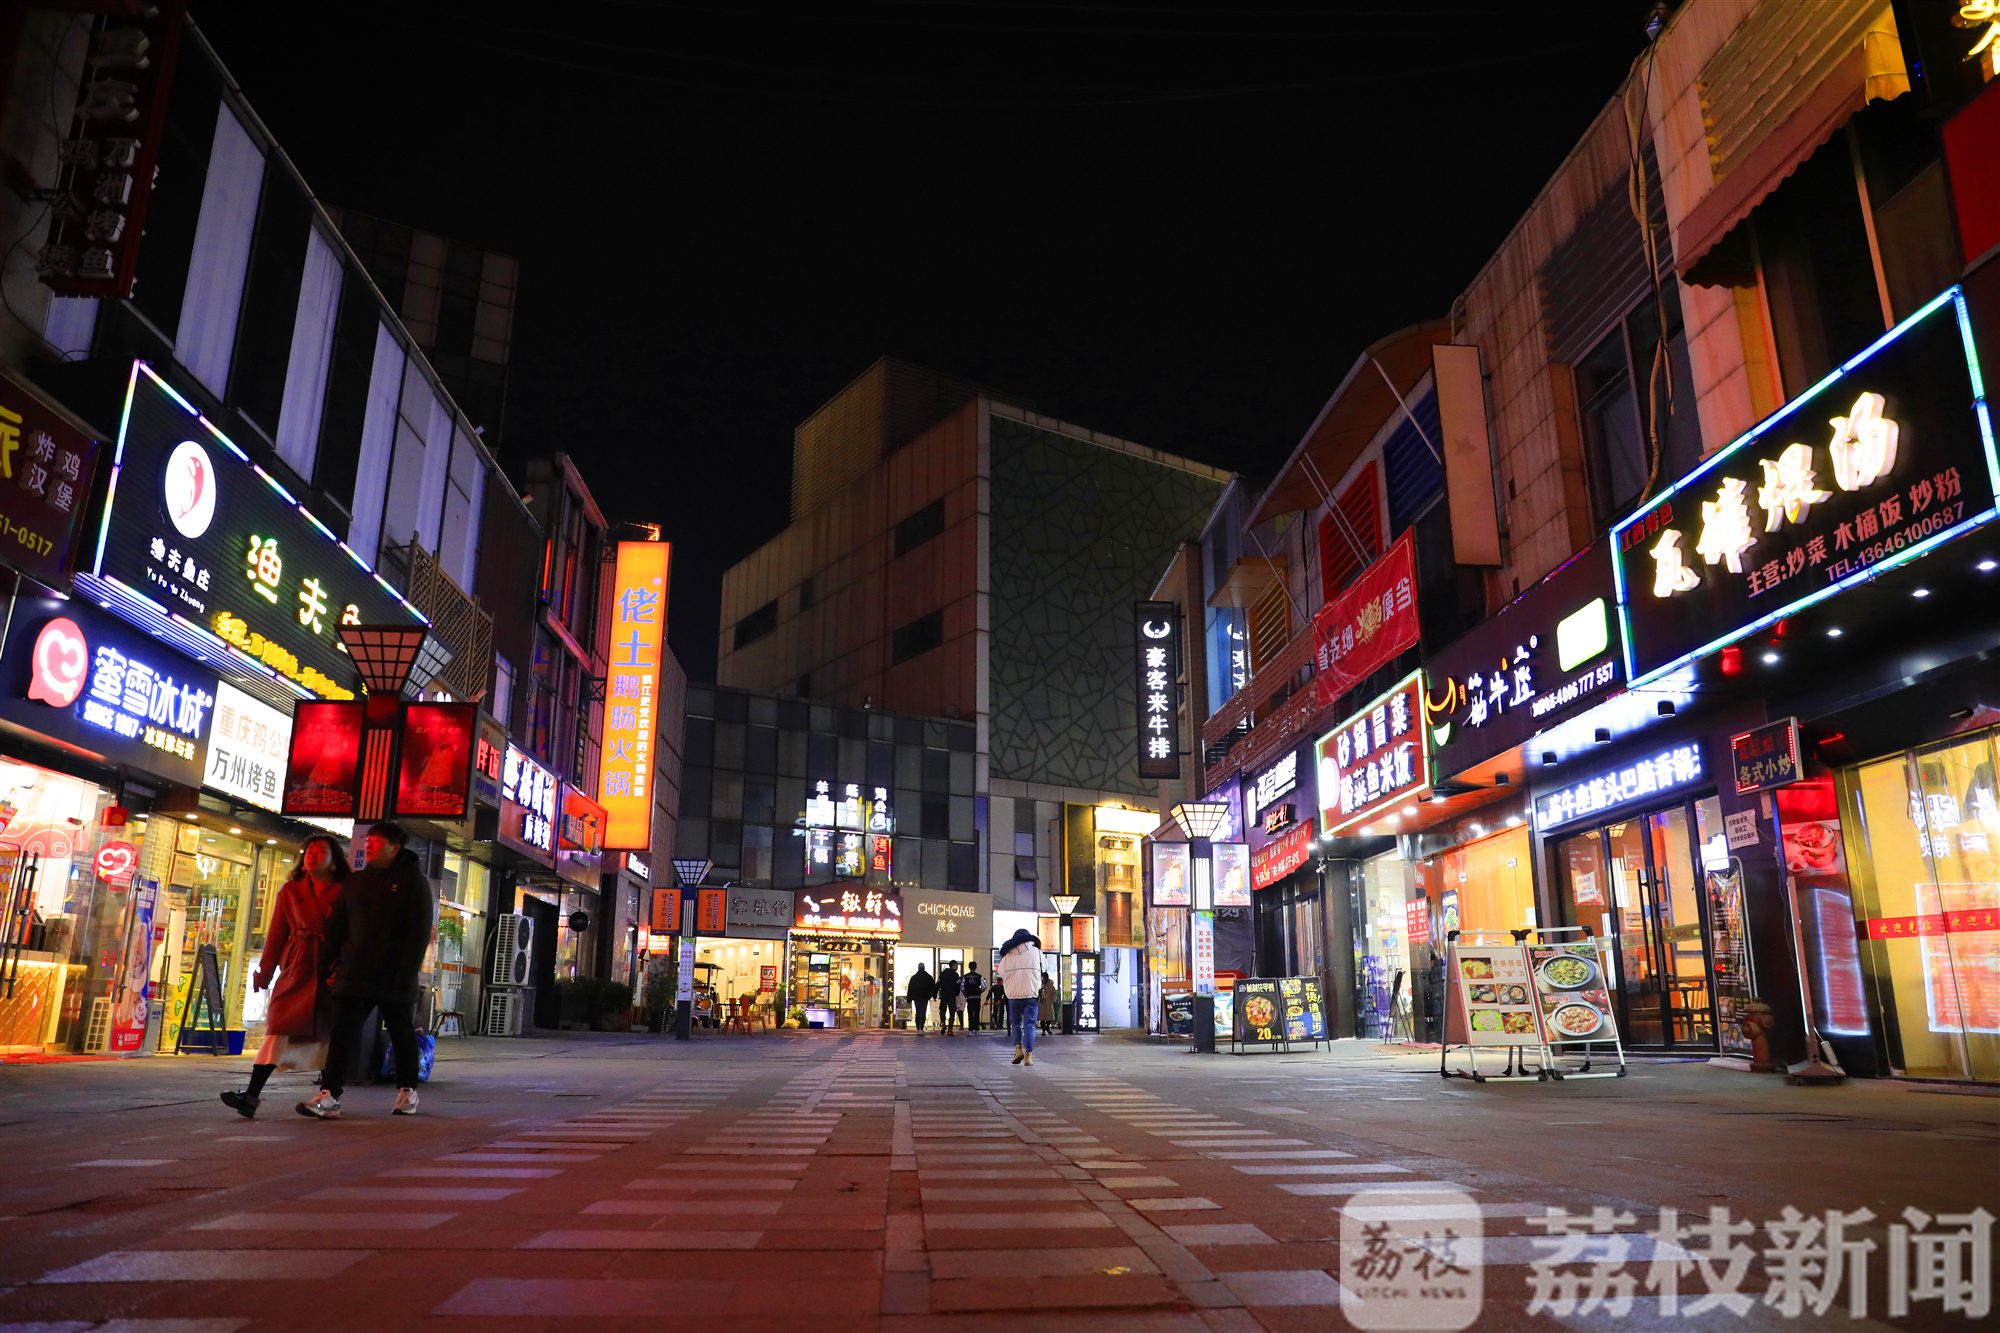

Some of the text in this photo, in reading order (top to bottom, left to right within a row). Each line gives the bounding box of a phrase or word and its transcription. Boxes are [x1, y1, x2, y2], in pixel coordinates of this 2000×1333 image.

[35, 431, 81, 482] 炸鸡
[28, 463, 74, 513] 汉堡
[1909, 466, 1961, 514] 炒粉
[1620, 502, 1674, 554] 江西特色
[1825, 501, 1965, 583] TEL:13646100687
[149, 536, 212, 593] 渔夫鱼庄
[157, 573, 168, 588] Fu
[179, 585, 206, 614] Zhuang
[90, 645, 204, 739] 蜜雪冰城
[604, 586, 659, 797] 佬土鹅肠火锅
[1596, 661, 1614, 686] 557
[1145, 646, 1171, 759] 豪客来牛排
[633, 674, 653, 797] 镇江更受欢迎的火锅连锁
[1336, 692, 1408, 769] 砂锅冒菜
[211, 747, 277, 800] 万州烤鱼
[1340, 741, 1414, 815] 酸菜鱼米饭
[1740, 753, 1791, 788] 各式小炒
[872, 836, 888, 871] 烤鱼
[917, 902, 975, 918] CHICHOME
[1879, 919, 1932, 934] 欢迎光临
[1951, 912, 1996, 927] 欢迎光
[1257, 1028, 1272, 1040] 20
